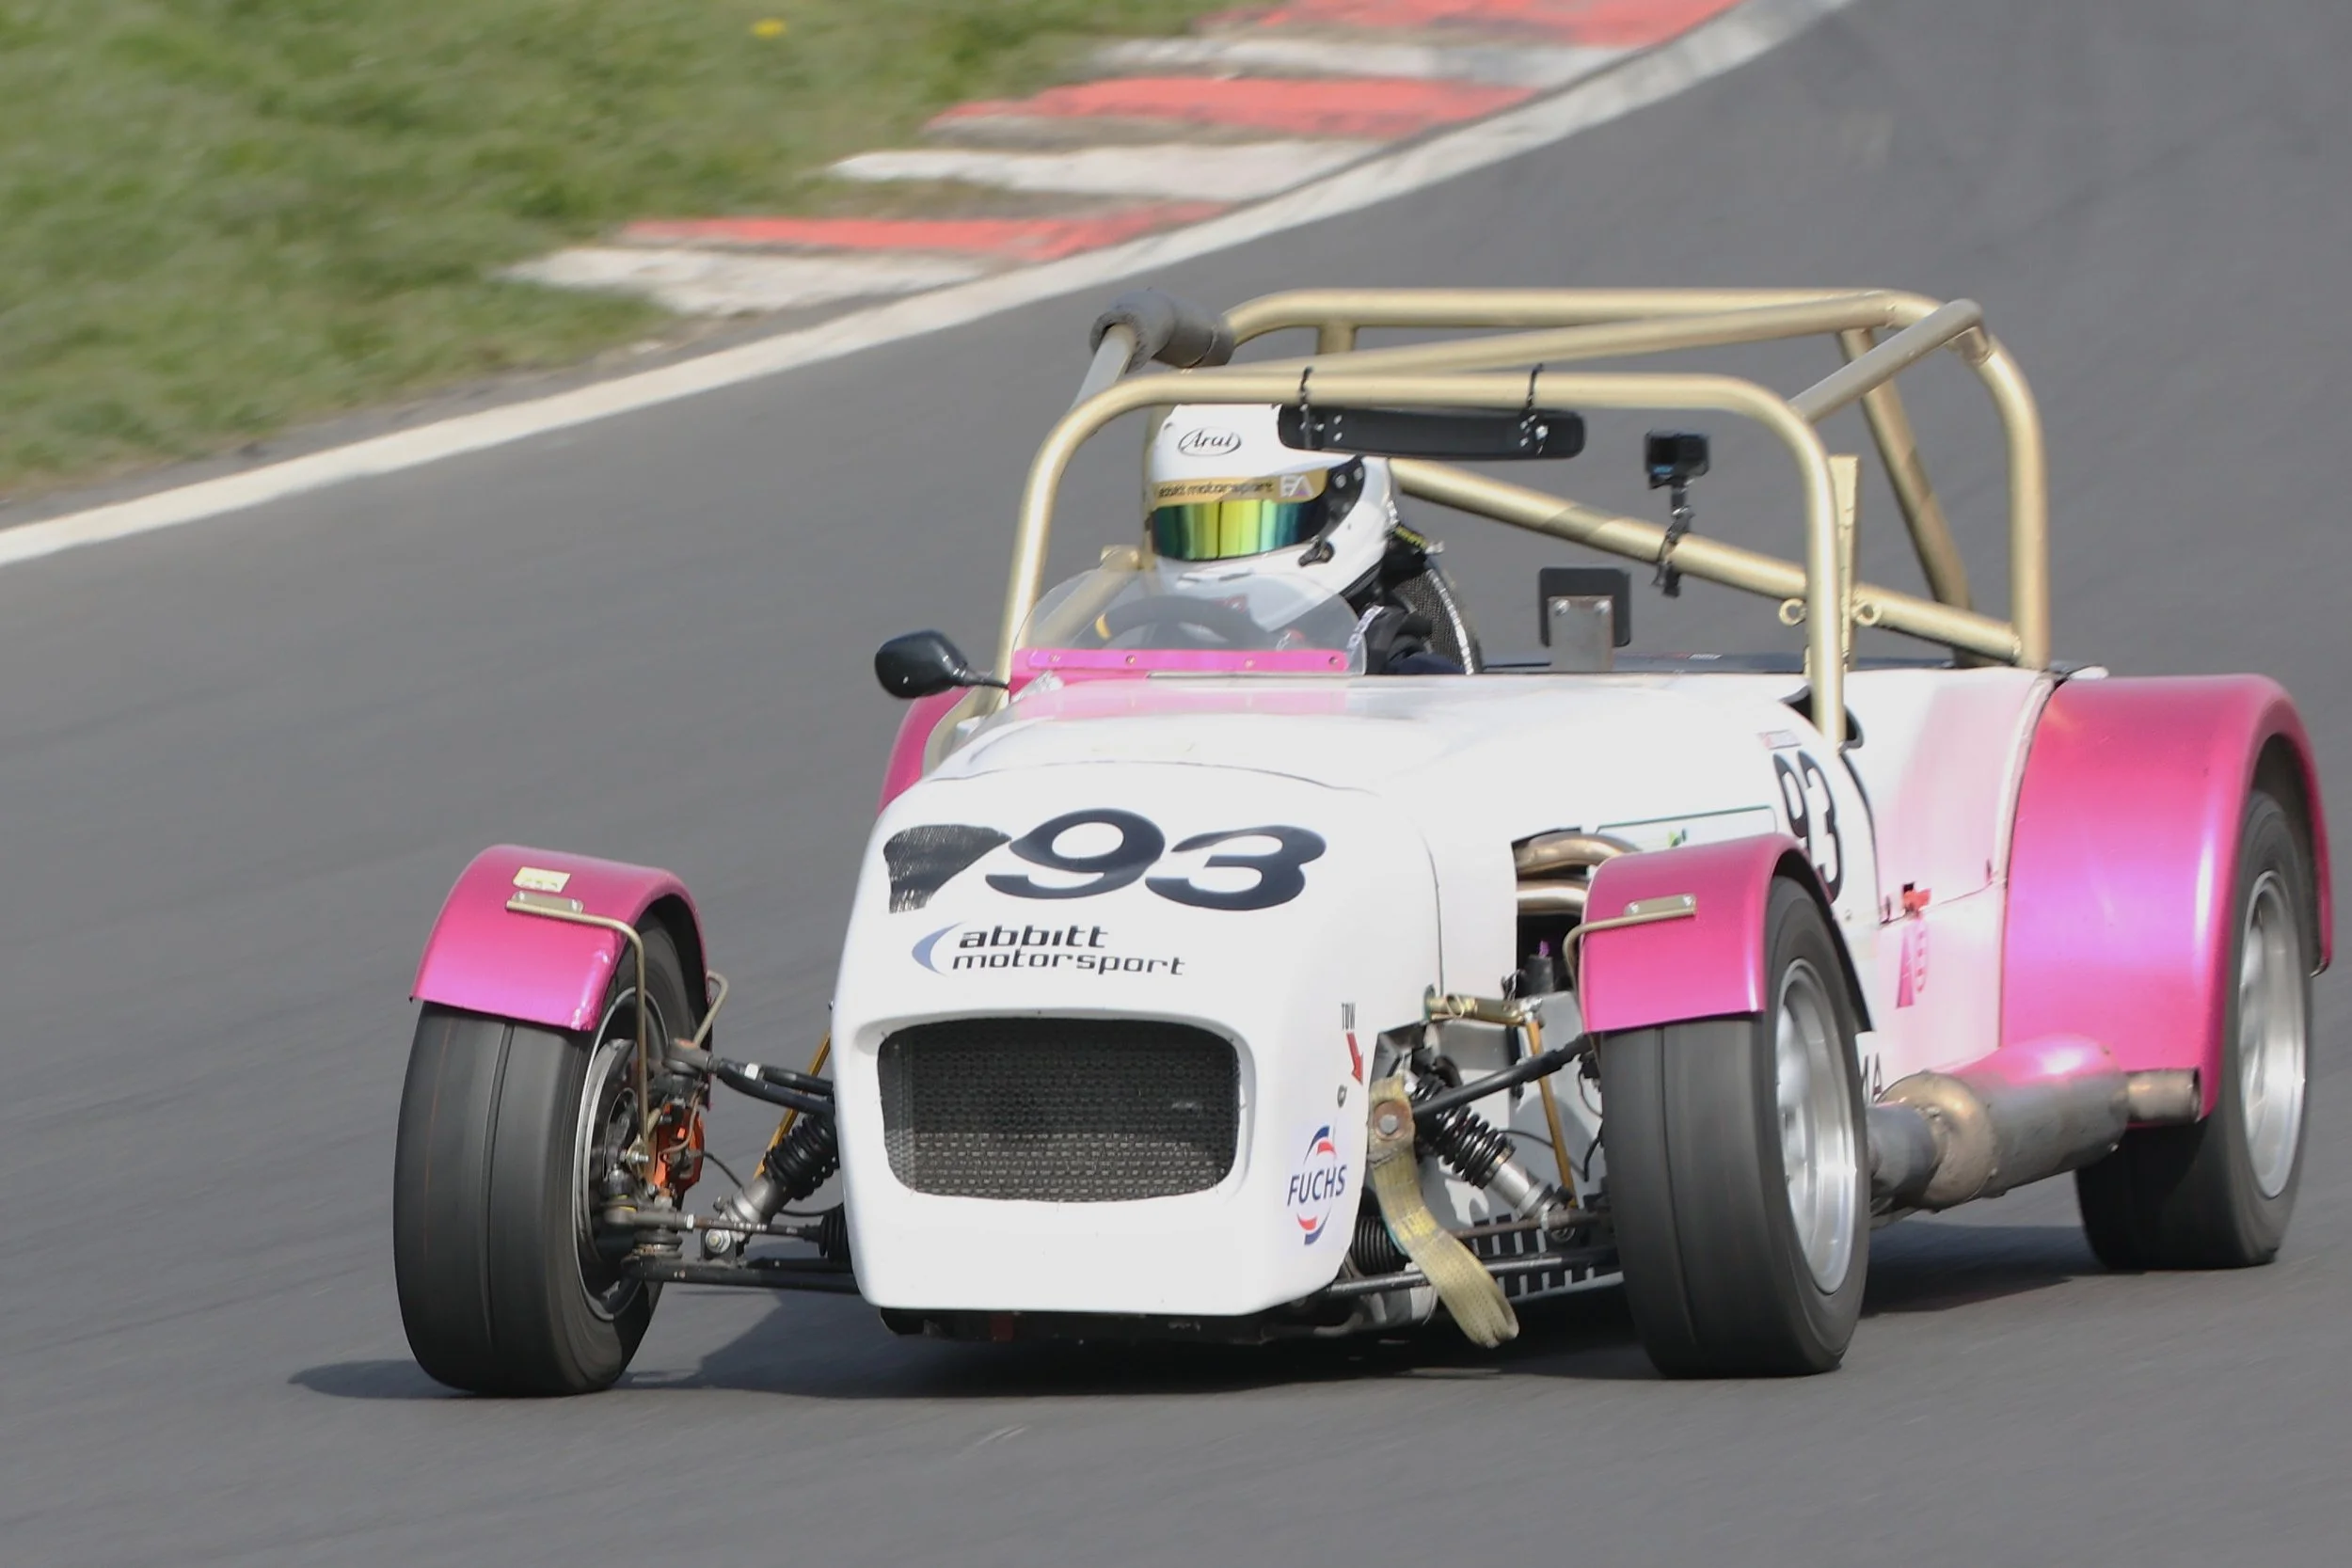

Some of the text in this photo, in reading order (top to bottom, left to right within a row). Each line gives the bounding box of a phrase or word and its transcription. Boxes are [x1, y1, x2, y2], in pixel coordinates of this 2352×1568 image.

[1180, 429, 1233, 451] Arai
[1772, 750, 1842, 905] 93
[985, 808, 1327, 911] 93
[959, 926, 1108, 949] abbitt
[952, 948, 1185, 976] motorsport
[1342, 1003, 1356, 1030] TOW
[1287, 1164, 1347, 1207] FUCHS
